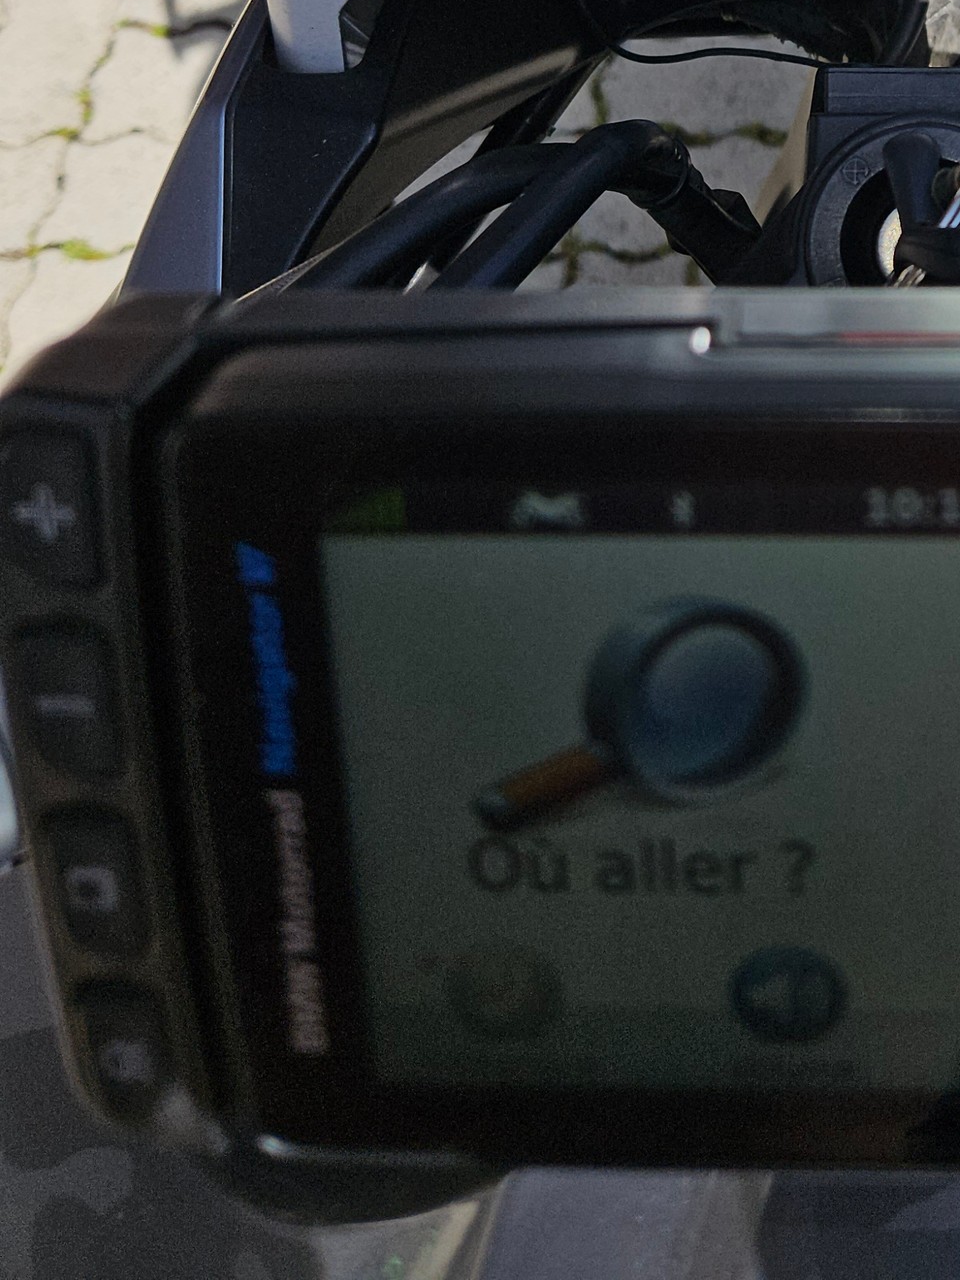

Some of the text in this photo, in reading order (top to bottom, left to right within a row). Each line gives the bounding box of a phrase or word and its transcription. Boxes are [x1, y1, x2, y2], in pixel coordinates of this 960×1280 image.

[467, 835, 818, 897] Où aller ?
